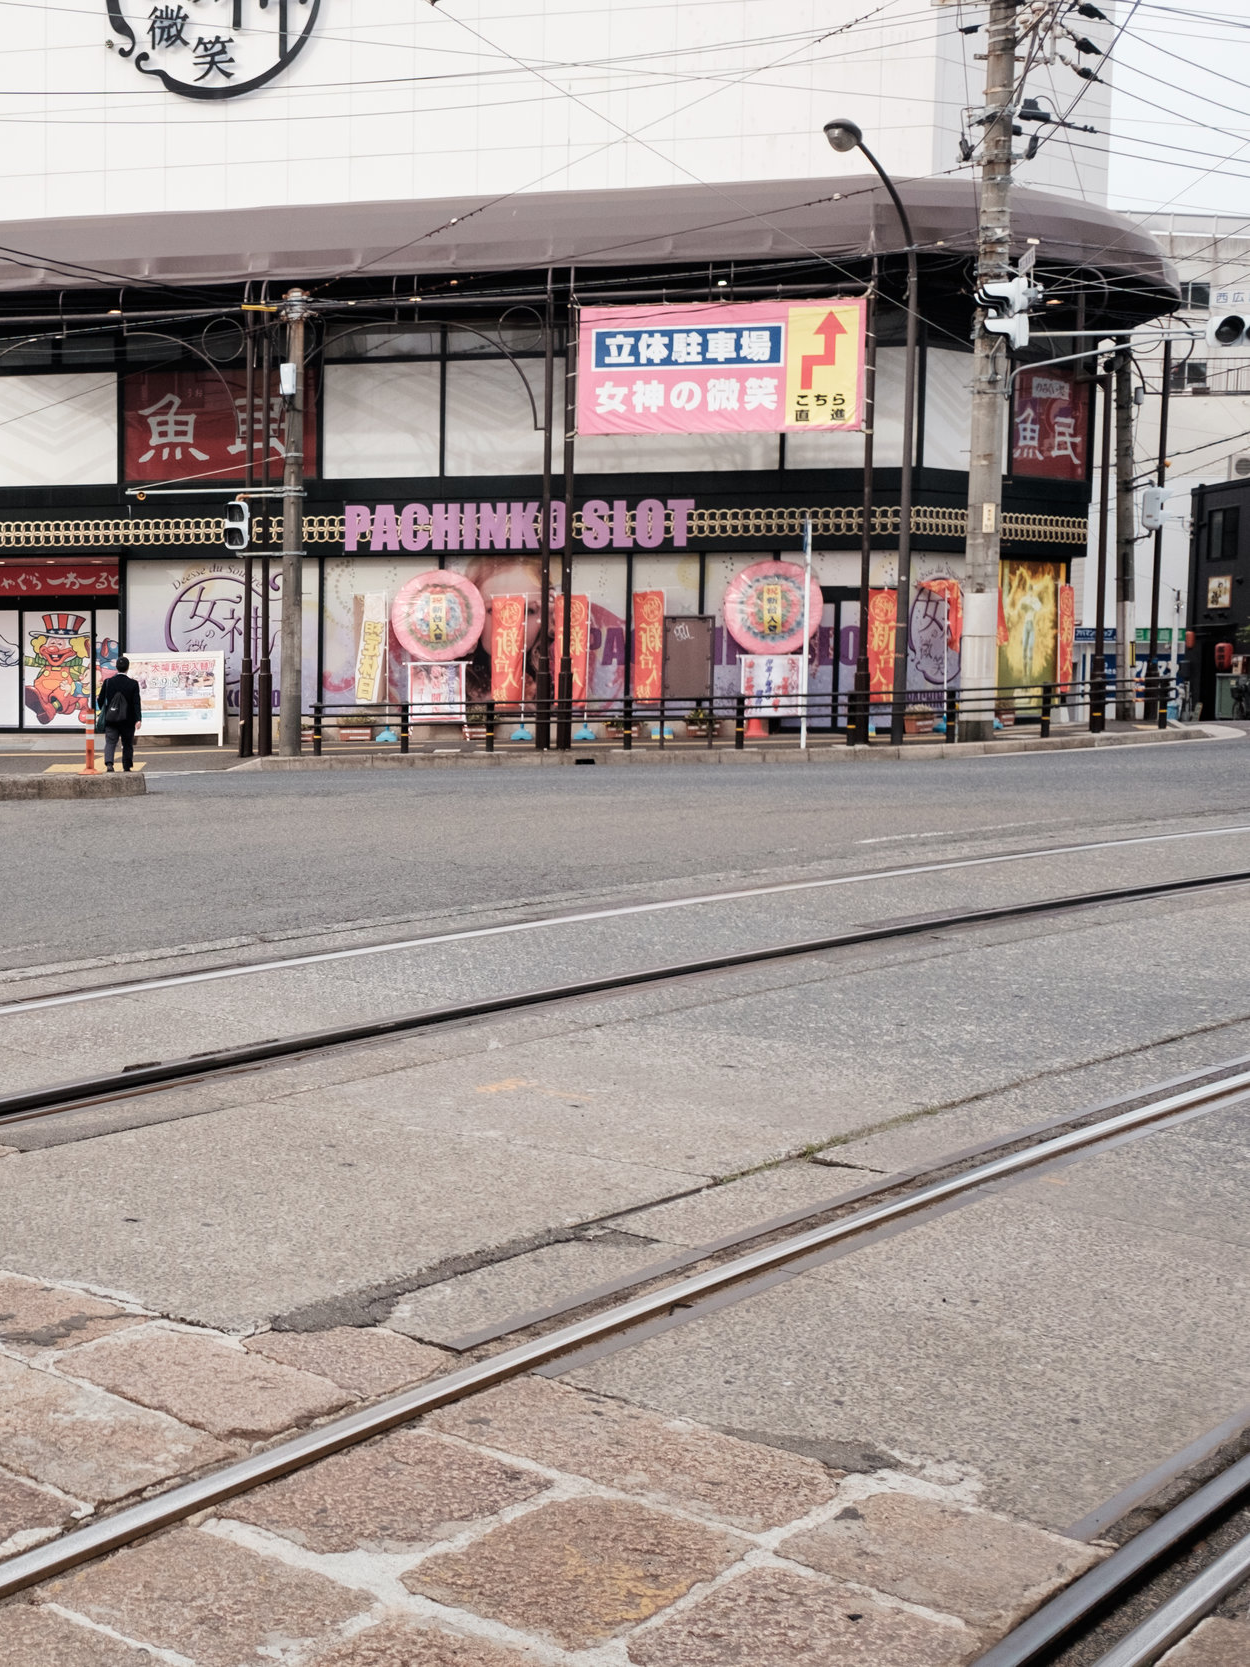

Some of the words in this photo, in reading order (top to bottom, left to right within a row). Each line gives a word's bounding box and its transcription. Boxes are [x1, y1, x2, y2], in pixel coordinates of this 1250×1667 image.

[1216, 292, 1250, 303] 西広
[604, 330, 771, 365] 立体駐車場
[595, 378, 779, 414] 女神の微笑
[796, 393, 845, 407] こちら
[138, 393, 286, 464] 魚民
[795, 409, 846, 422] 直進
[1013, 408, 1082, 465] 魚民
[345, 501, 567, 551] PACHINKO
[582, 499, 695, 548] SLOT
